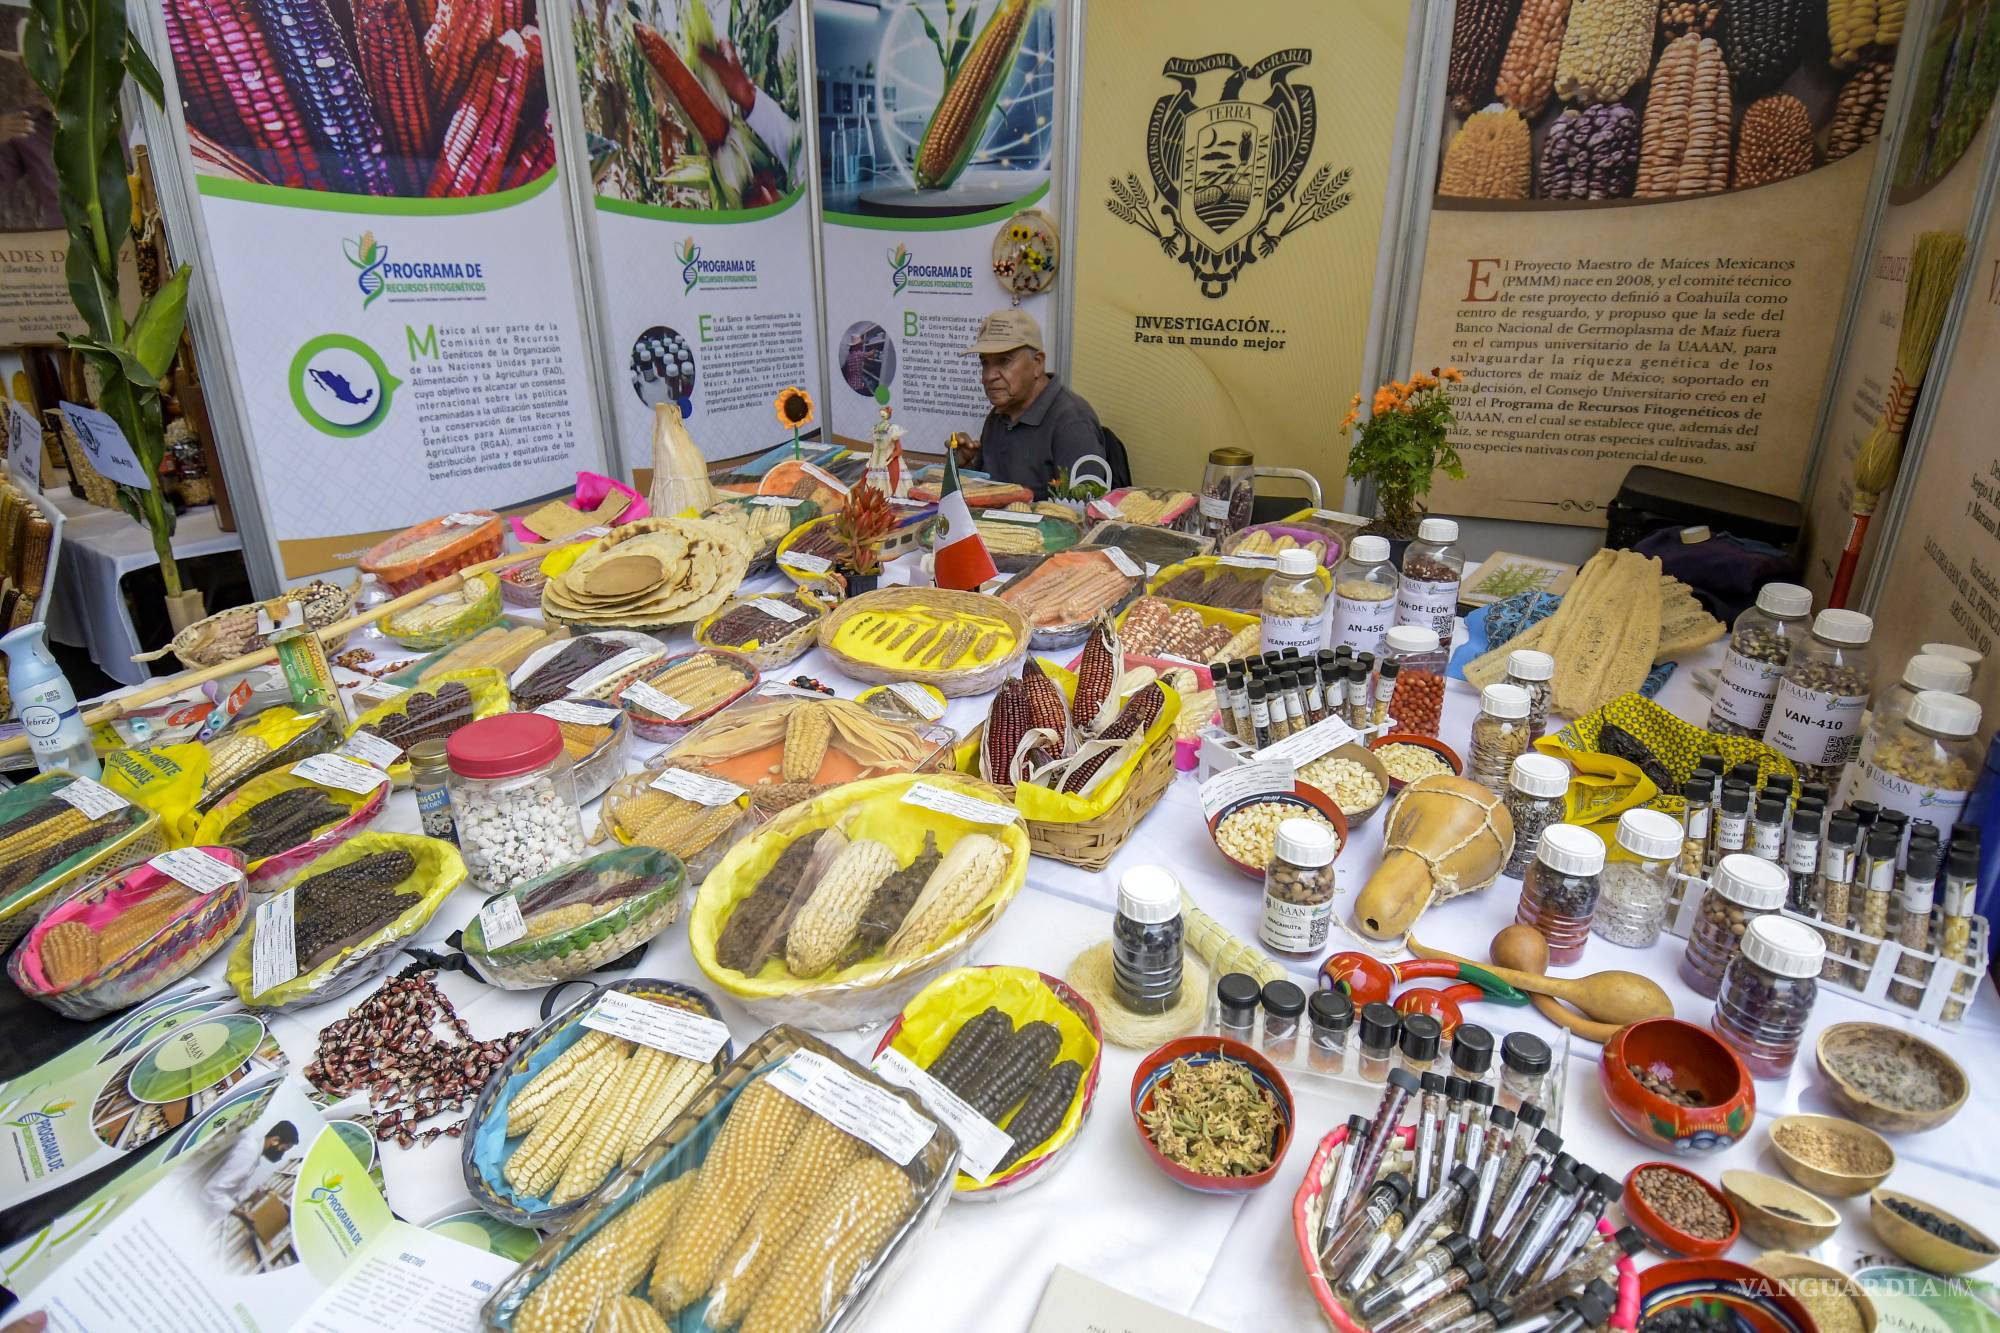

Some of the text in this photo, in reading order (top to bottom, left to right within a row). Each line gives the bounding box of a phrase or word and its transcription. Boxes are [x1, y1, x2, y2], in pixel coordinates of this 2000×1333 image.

[1255, 50, 1310, 77] AGRARIA
[1207, 105, 1251, 121] TERRA
[1150, 88, 1313, 200] UNIVERSIDAD ANTONIO NARRO
[1184, 134, 1269, 198] ALMA MATER
[383, 263, 483, 278] PROGRAMA DE
[697, 260, 756, 272] PROGRAMA DE
[907, 265, 972, 278] PROGRAMA DE
[386, 283, 428, 293] RECURSOS
[1135, 332, 1286, 351] Para un mundo mejor
[1426, 606, 1449, 614] LEÓN
[1348, 624, 1384, 633] AN-456
[1785, 683, 1818, 702] UAAAN
[1785, 708, 1843, 730] VAN-410
[1873, 774, 1912, 795] UAAAN
[1273, 902, 1306, 916] UAAAN
[327, 1193, 357, 1238] PROGRAMA
[352, 1232, 363, 1246] DE
